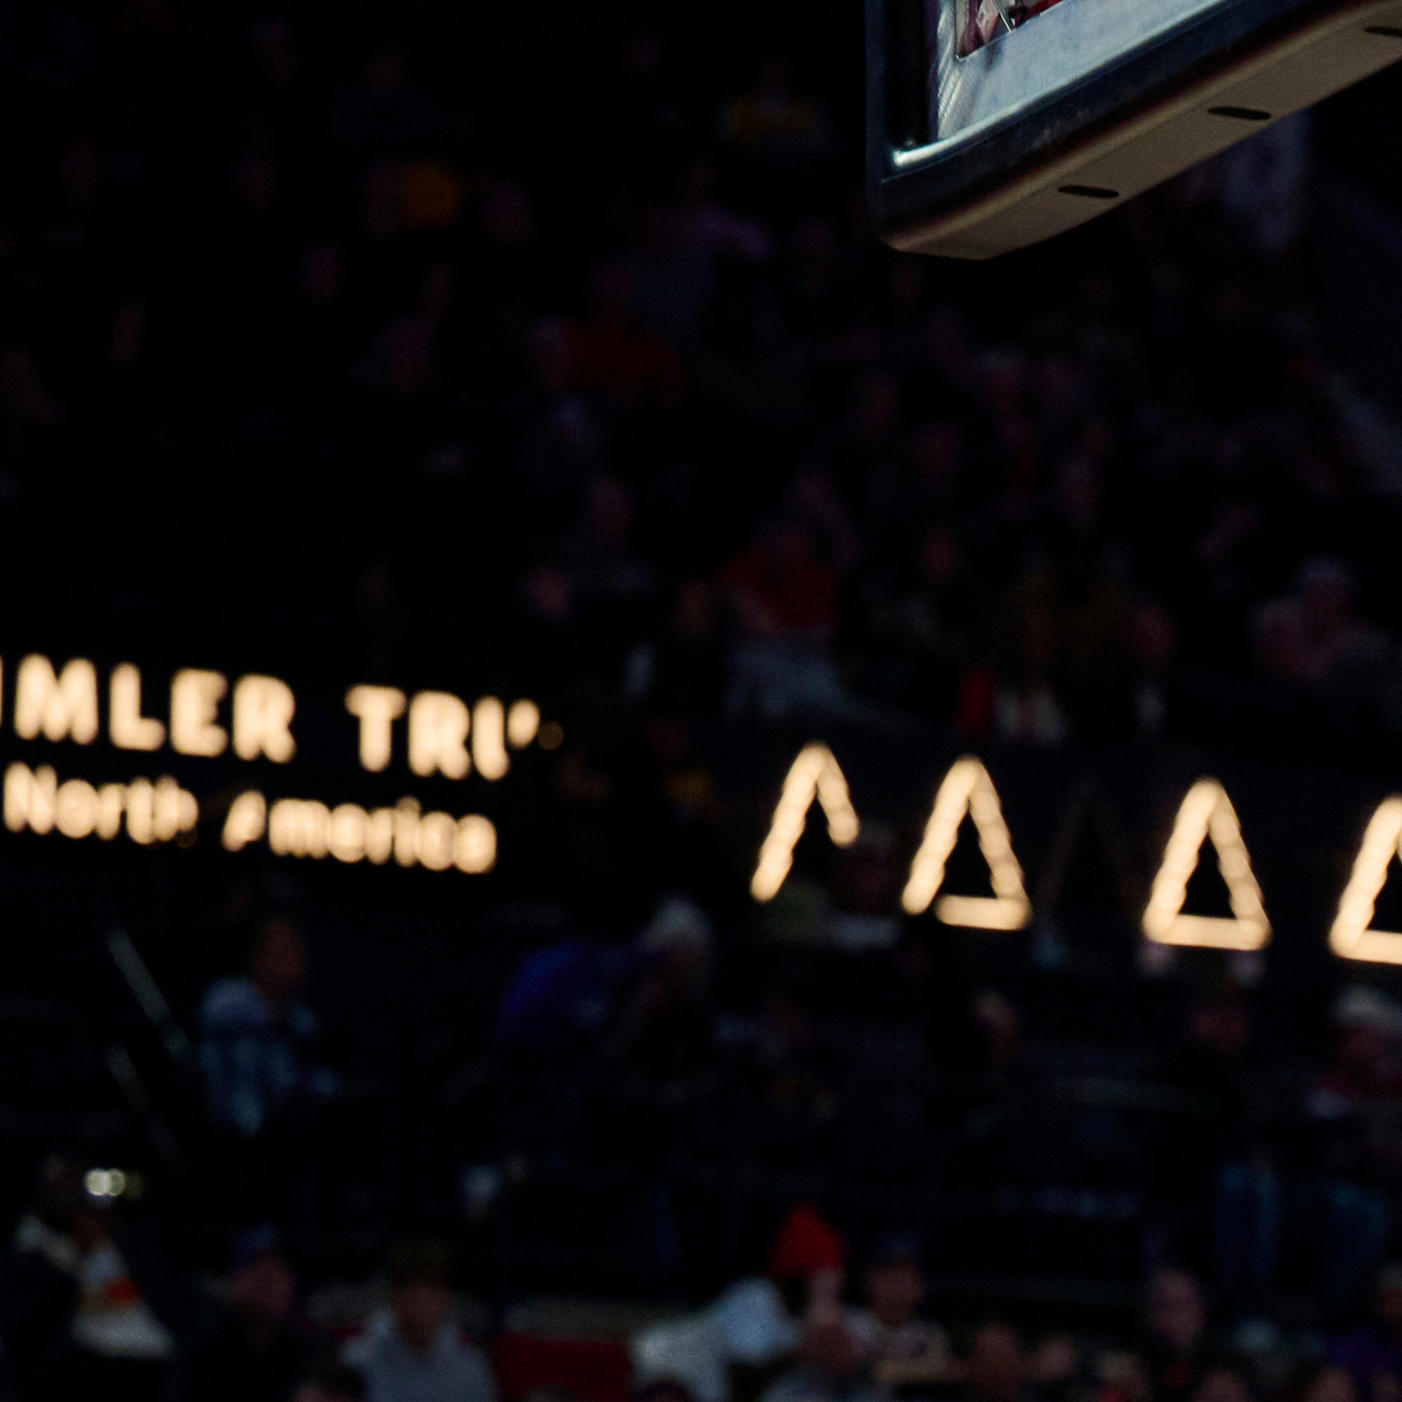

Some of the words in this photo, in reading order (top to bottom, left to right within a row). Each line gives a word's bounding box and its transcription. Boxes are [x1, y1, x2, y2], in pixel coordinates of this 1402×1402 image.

[0, 653, 297, 764] MLER
[3, 762, 198, 845] North
[221, 790, 497, 874] America
